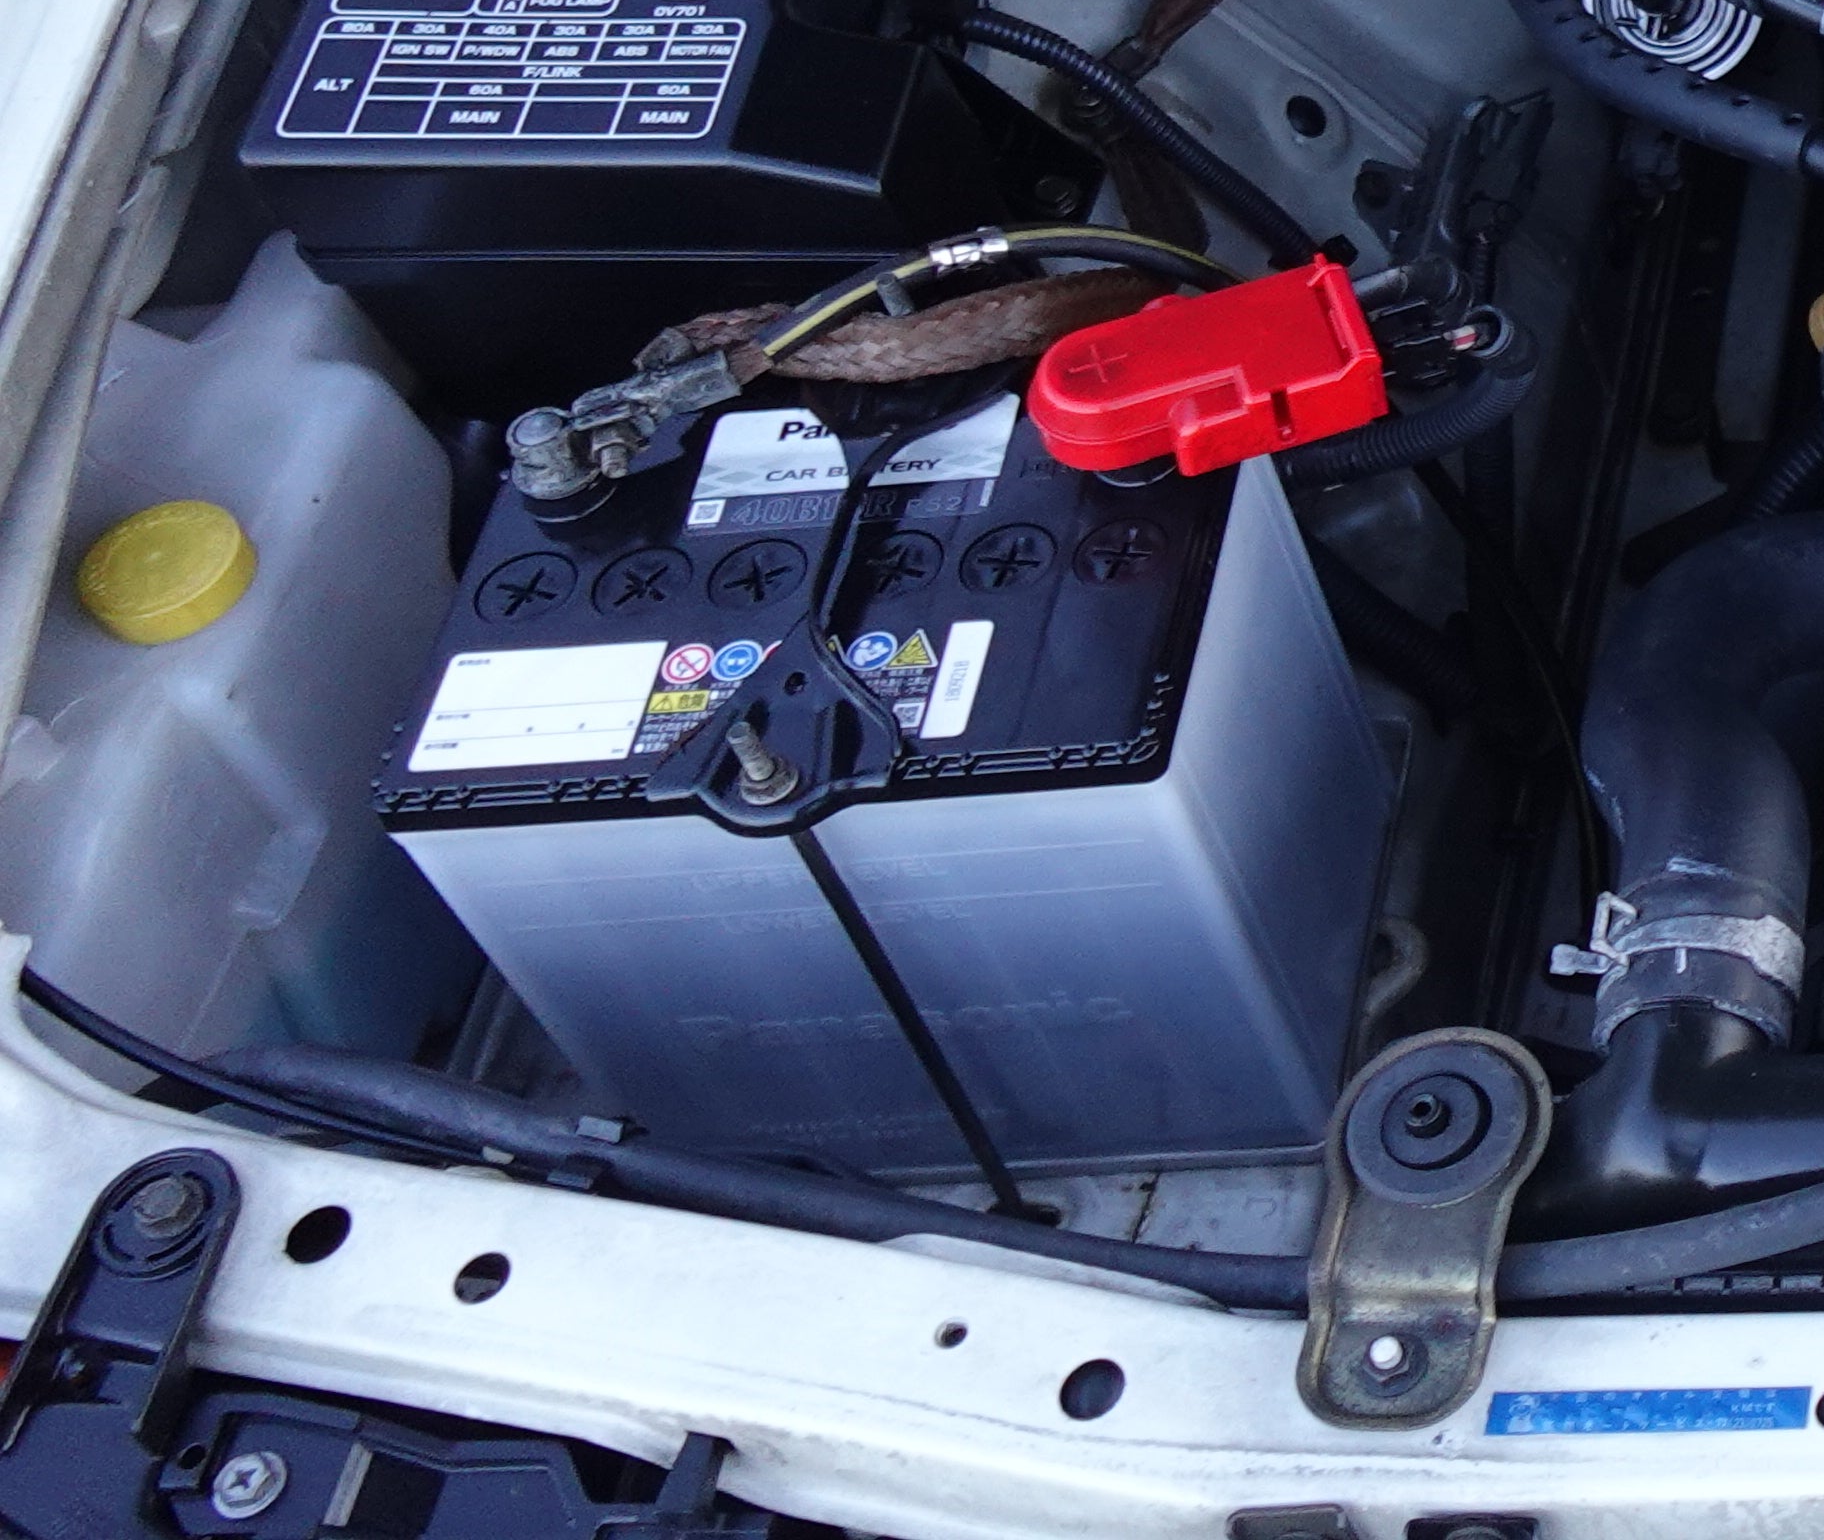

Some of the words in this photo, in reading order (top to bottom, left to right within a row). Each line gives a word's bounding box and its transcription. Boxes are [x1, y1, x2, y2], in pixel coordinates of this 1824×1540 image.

[412, 23, 447, 35] 30A
[482, 24, 517, 36] 40A
[553, 25, 587, 37] 30A
[621, 24, 656, 36] 30A
[690, 23, 725, 35] 30A
[390, 43, 421, 56] IGN
[421, 43, 451, 56] SW
[543, 45, 580, 58] ABS
[613, 45, 649, 57] ABS
[670, 44, 706, 56] MOTOR
[706, 44, 732, 56] FAN
[522, 65, 582, 78] F/LINK
[313, 77, 355, 92] ALT
[468, 84, 503, 96] 60A
[656, 83, 691, 95] 60A
[449, 111, 502, 124] MAIN
[639, 110, 691, 124] MAIN
[765, 467, 817, 481] CAR
[825, 458, 943, 478] BTERY
[731, 491, 898, 526] 40B1R
